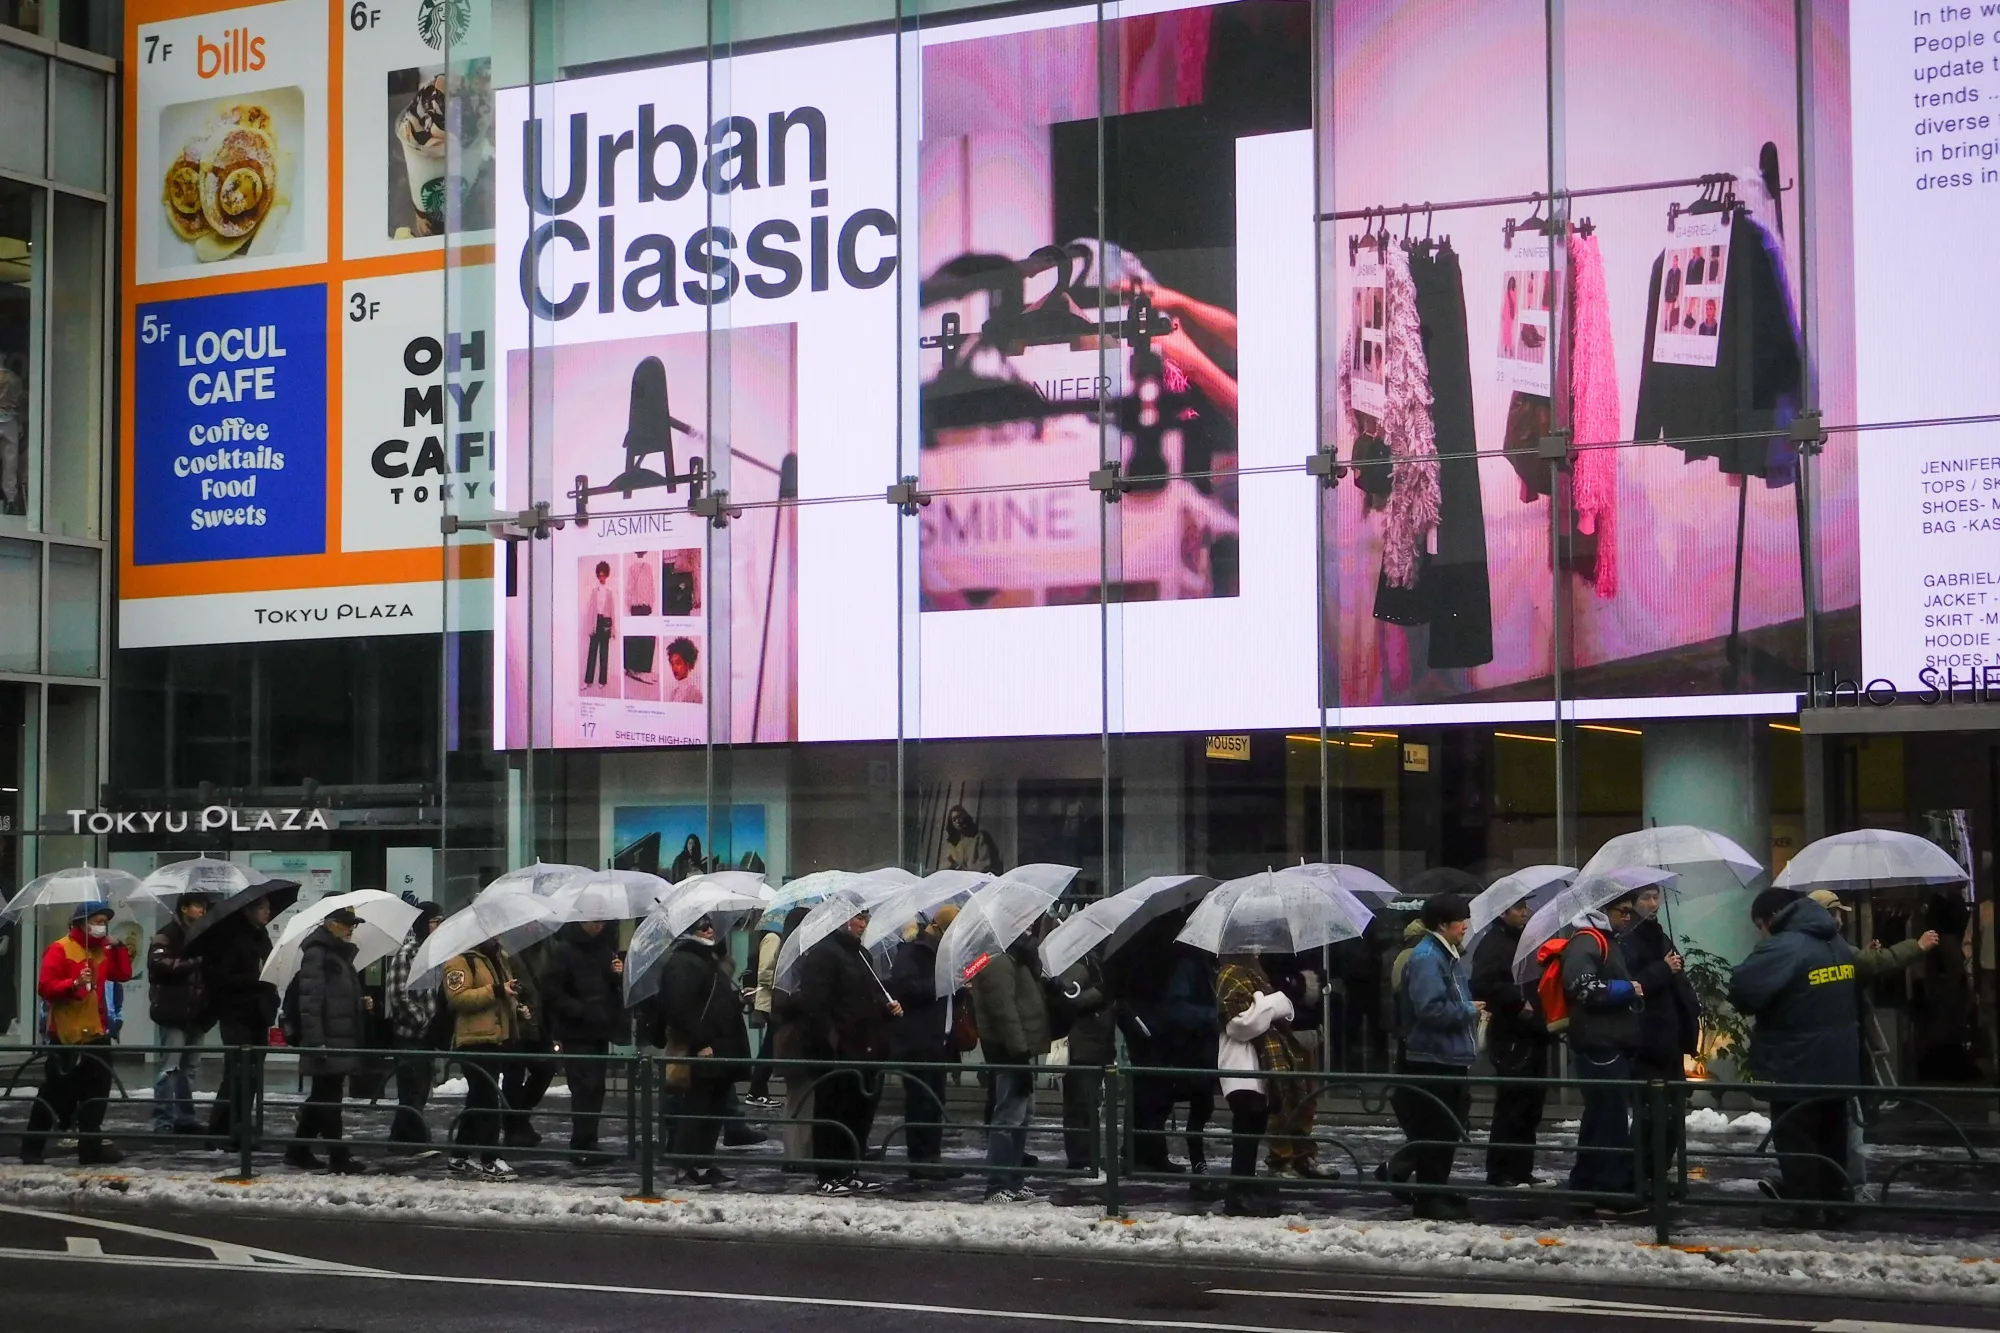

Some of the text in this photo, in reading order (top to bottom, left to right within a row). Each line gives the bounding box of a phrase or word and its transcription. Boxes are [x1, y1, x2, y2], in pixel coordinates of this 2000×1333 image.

[350, 1, 381, 31] 6F
[1914, 10, 1931, 26] In
[1940, 6, 1971, 22] the
[144, 35, 172, 64] 7F
[198, 27, 266, 79] bills
[1914, 31, 1984, 53] People
[1914, 59, 1984, 83] update
[1914, 86, 1979, 108] trends
[1915, 115, 1989, 136] diverse
[522, 103, 827, 216] Urban
[1916, 147, 1932, 163] in
[1916, 167, 1998, 190] dress in
[519, 188, 897, 321] Classic
[349, 293, 380, 322] 3F
[142, 315, 171, 344] 5F
[179, 325, 286, 366] LOCUL
[404, 330, 485, 376] OH
[188, 366, 275, 406] CAFE
[404, 381, 485, 427] MY
[189, 417, 269, 446] Coffee
[174, 445, 285, 477] Cocktails
[371, 431, 495, 478] CAF
[1921, 457, 2000, 474] JENNIFER
[202, 475, 256, 500] Food
[1921, 480, 1965, 494] TOPS
[191, 504, 267, 530] Sweets
[598, 512, 673, 537] JASMINE
[1923, 520, 1955, 534] BAG
[1924, 593, 1987, 607] JACKET
[254, 604, 413, 624] TOKYU PLAZA
[1925, 614, 1973, 627] SKIRT
[1925, 633, 1990, 647] HOODIE
[582, 722, 596, 738] 17
[1205, 736, 1247, 751] MOUSSY
[67, 805, 329, 834] TOKYU PLAZA
[404, 874, 414, 884] 5F
[965, 955, 988, 976] Supreme
